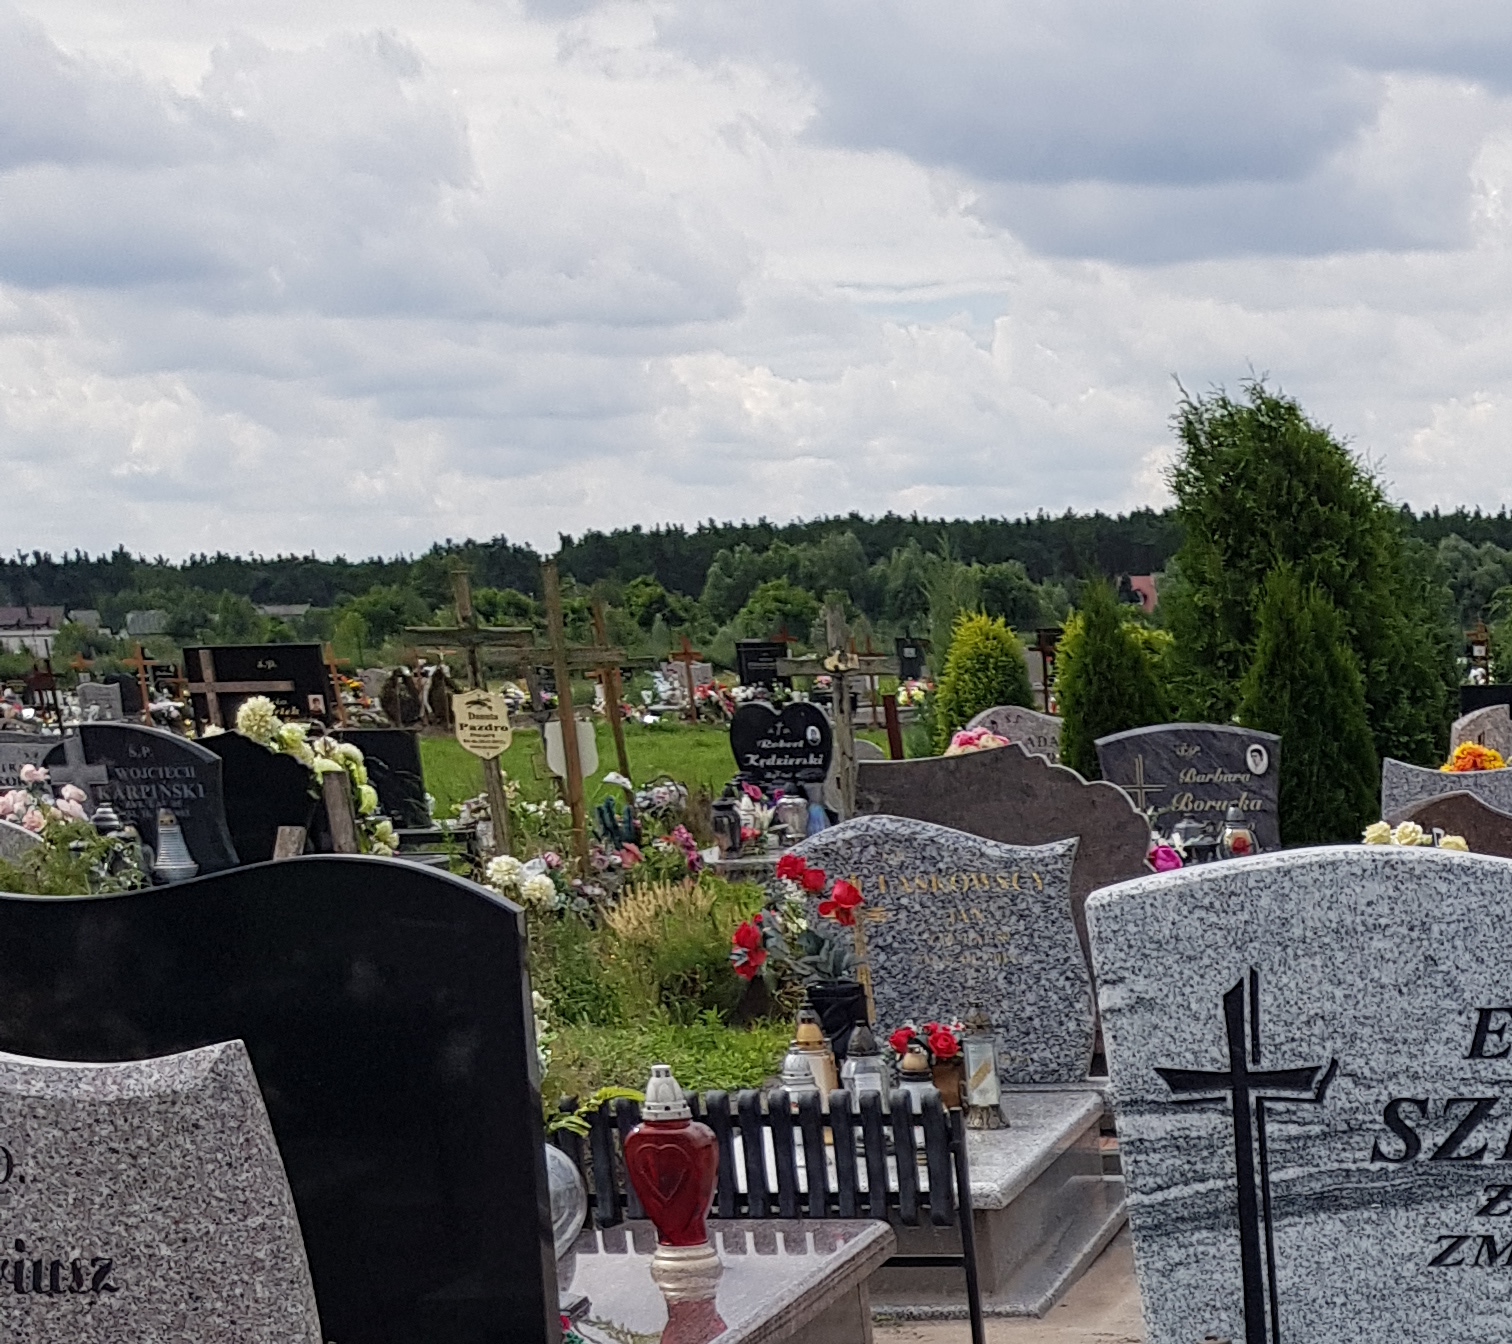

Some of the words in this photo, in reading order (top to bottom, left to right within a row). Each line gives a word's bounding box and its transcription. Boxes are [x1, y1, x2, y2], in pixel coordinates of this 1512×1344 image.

[459, 723, 509, 731] Pazdro
[114, 765, 196, 779] WOJCIECH
[1179, 767, 1251, 784] Barbara
[97, 781, 205, 800] KARPIŃSKI
[1171, 791, 1263, 812] Boruka
[0, 1239, 120, 1295] iusz
